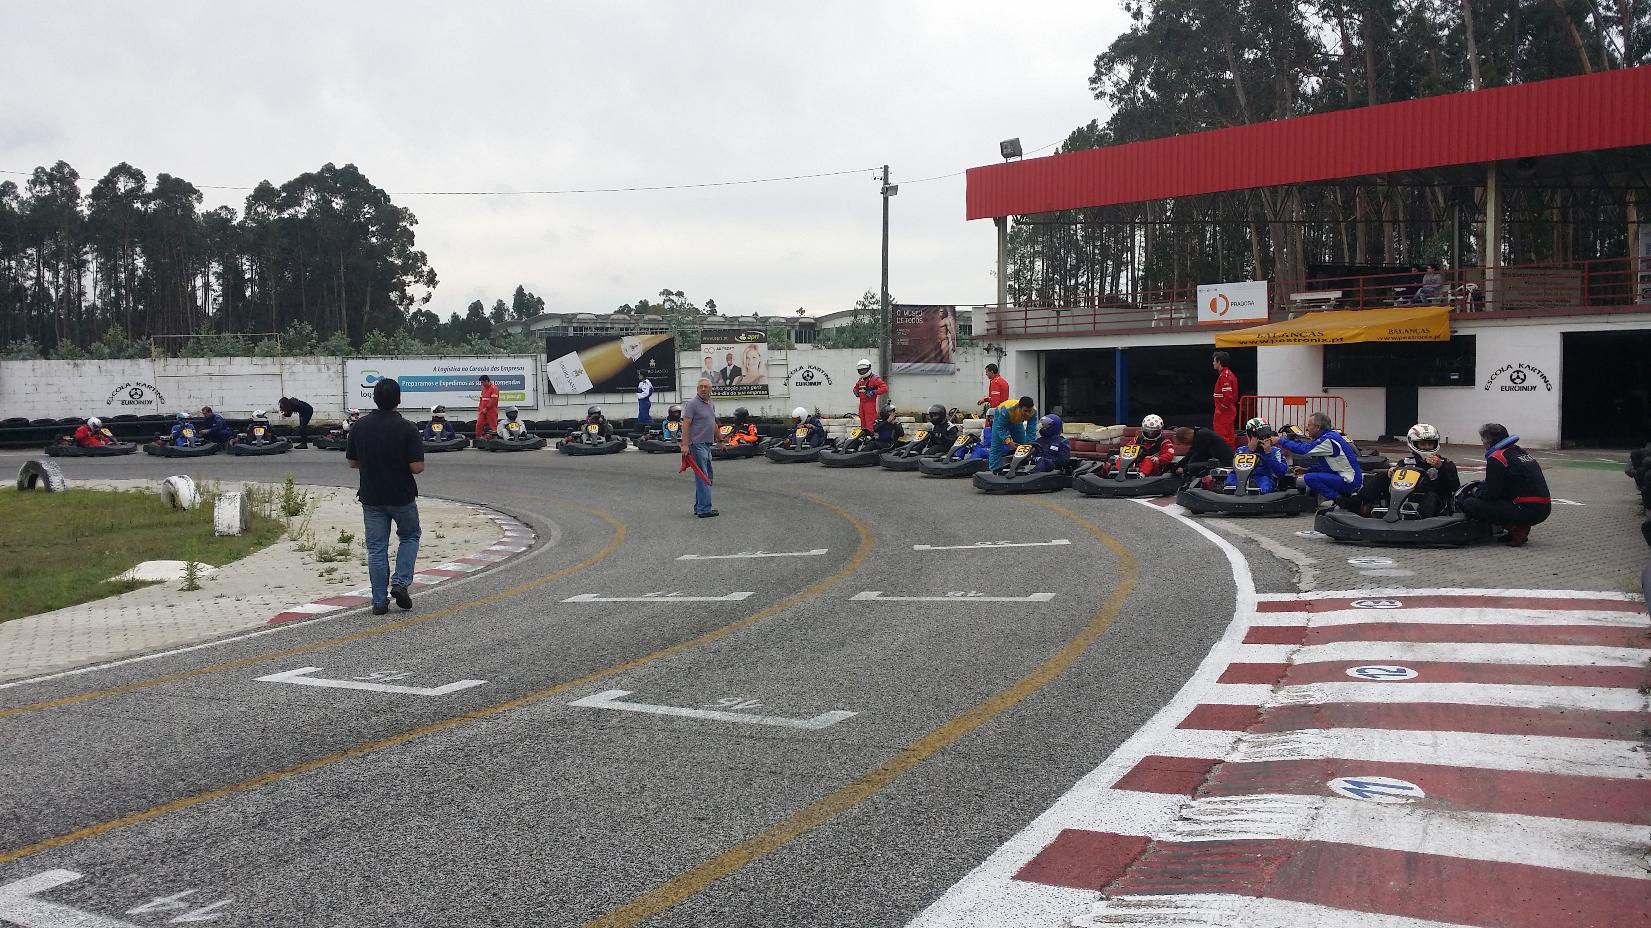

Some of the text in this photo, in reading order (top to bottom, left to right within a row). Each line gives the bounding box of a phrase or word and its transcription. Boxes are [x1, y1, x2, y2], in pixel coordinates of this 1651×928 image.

[1484, 363, 1552, 392] ESCOLA KARTING
[106, 382, 132, 406] ESCOLA
[1238, 454, 1255, 464] 22
[1397, 469, 1408, 481] 9
[1355, 667, 1408, 679] 12
[1341, 779, 1415, 799] 11
